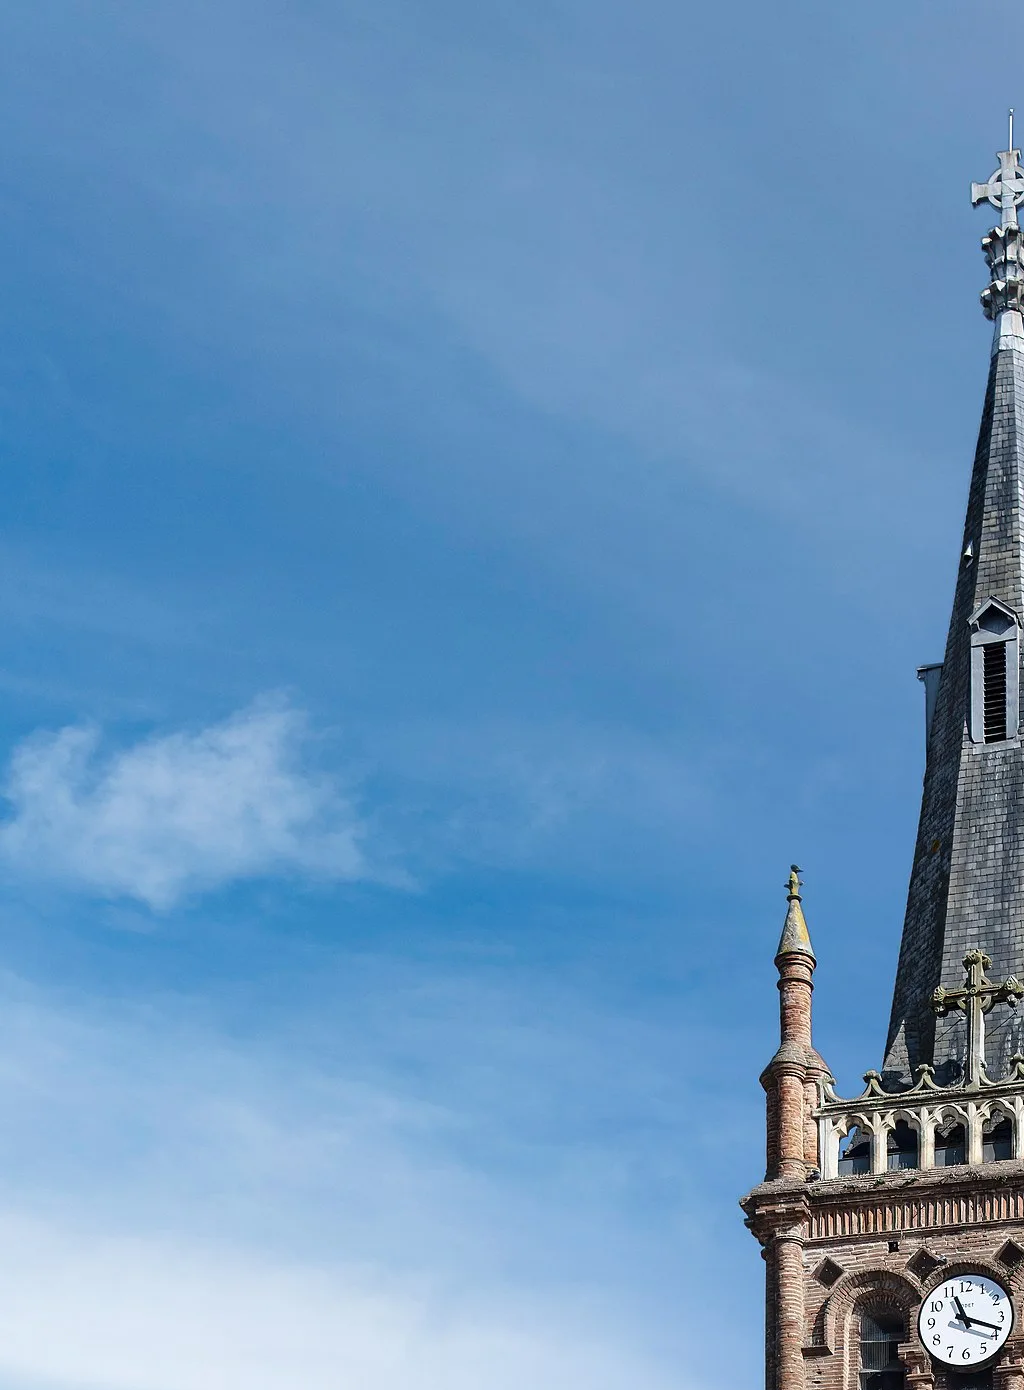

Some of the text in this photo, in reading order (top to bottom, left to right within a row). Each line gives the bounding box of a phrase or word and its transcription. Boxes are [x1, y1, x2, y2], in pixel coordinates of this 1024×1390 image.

[944, 1286, 955, 1298] 11
[960, 1281, 973, 1293] 12
[980, 1284, 986, 1294] 1
[930, 1300, 943, 1312] 10
[992, 1294, 1000, 1306] 2
[997, 1310, 1004, 1322] 3
[928, 1318, 935, 1330] 9
[932, 1334, 941, 1346] 8
[990, 1329, 999, 1340] 4
[946, 1346, 954, 1358] 7
[962, 1348, 970, 1359] 6
[980, 1342, 987, 1354] 5
